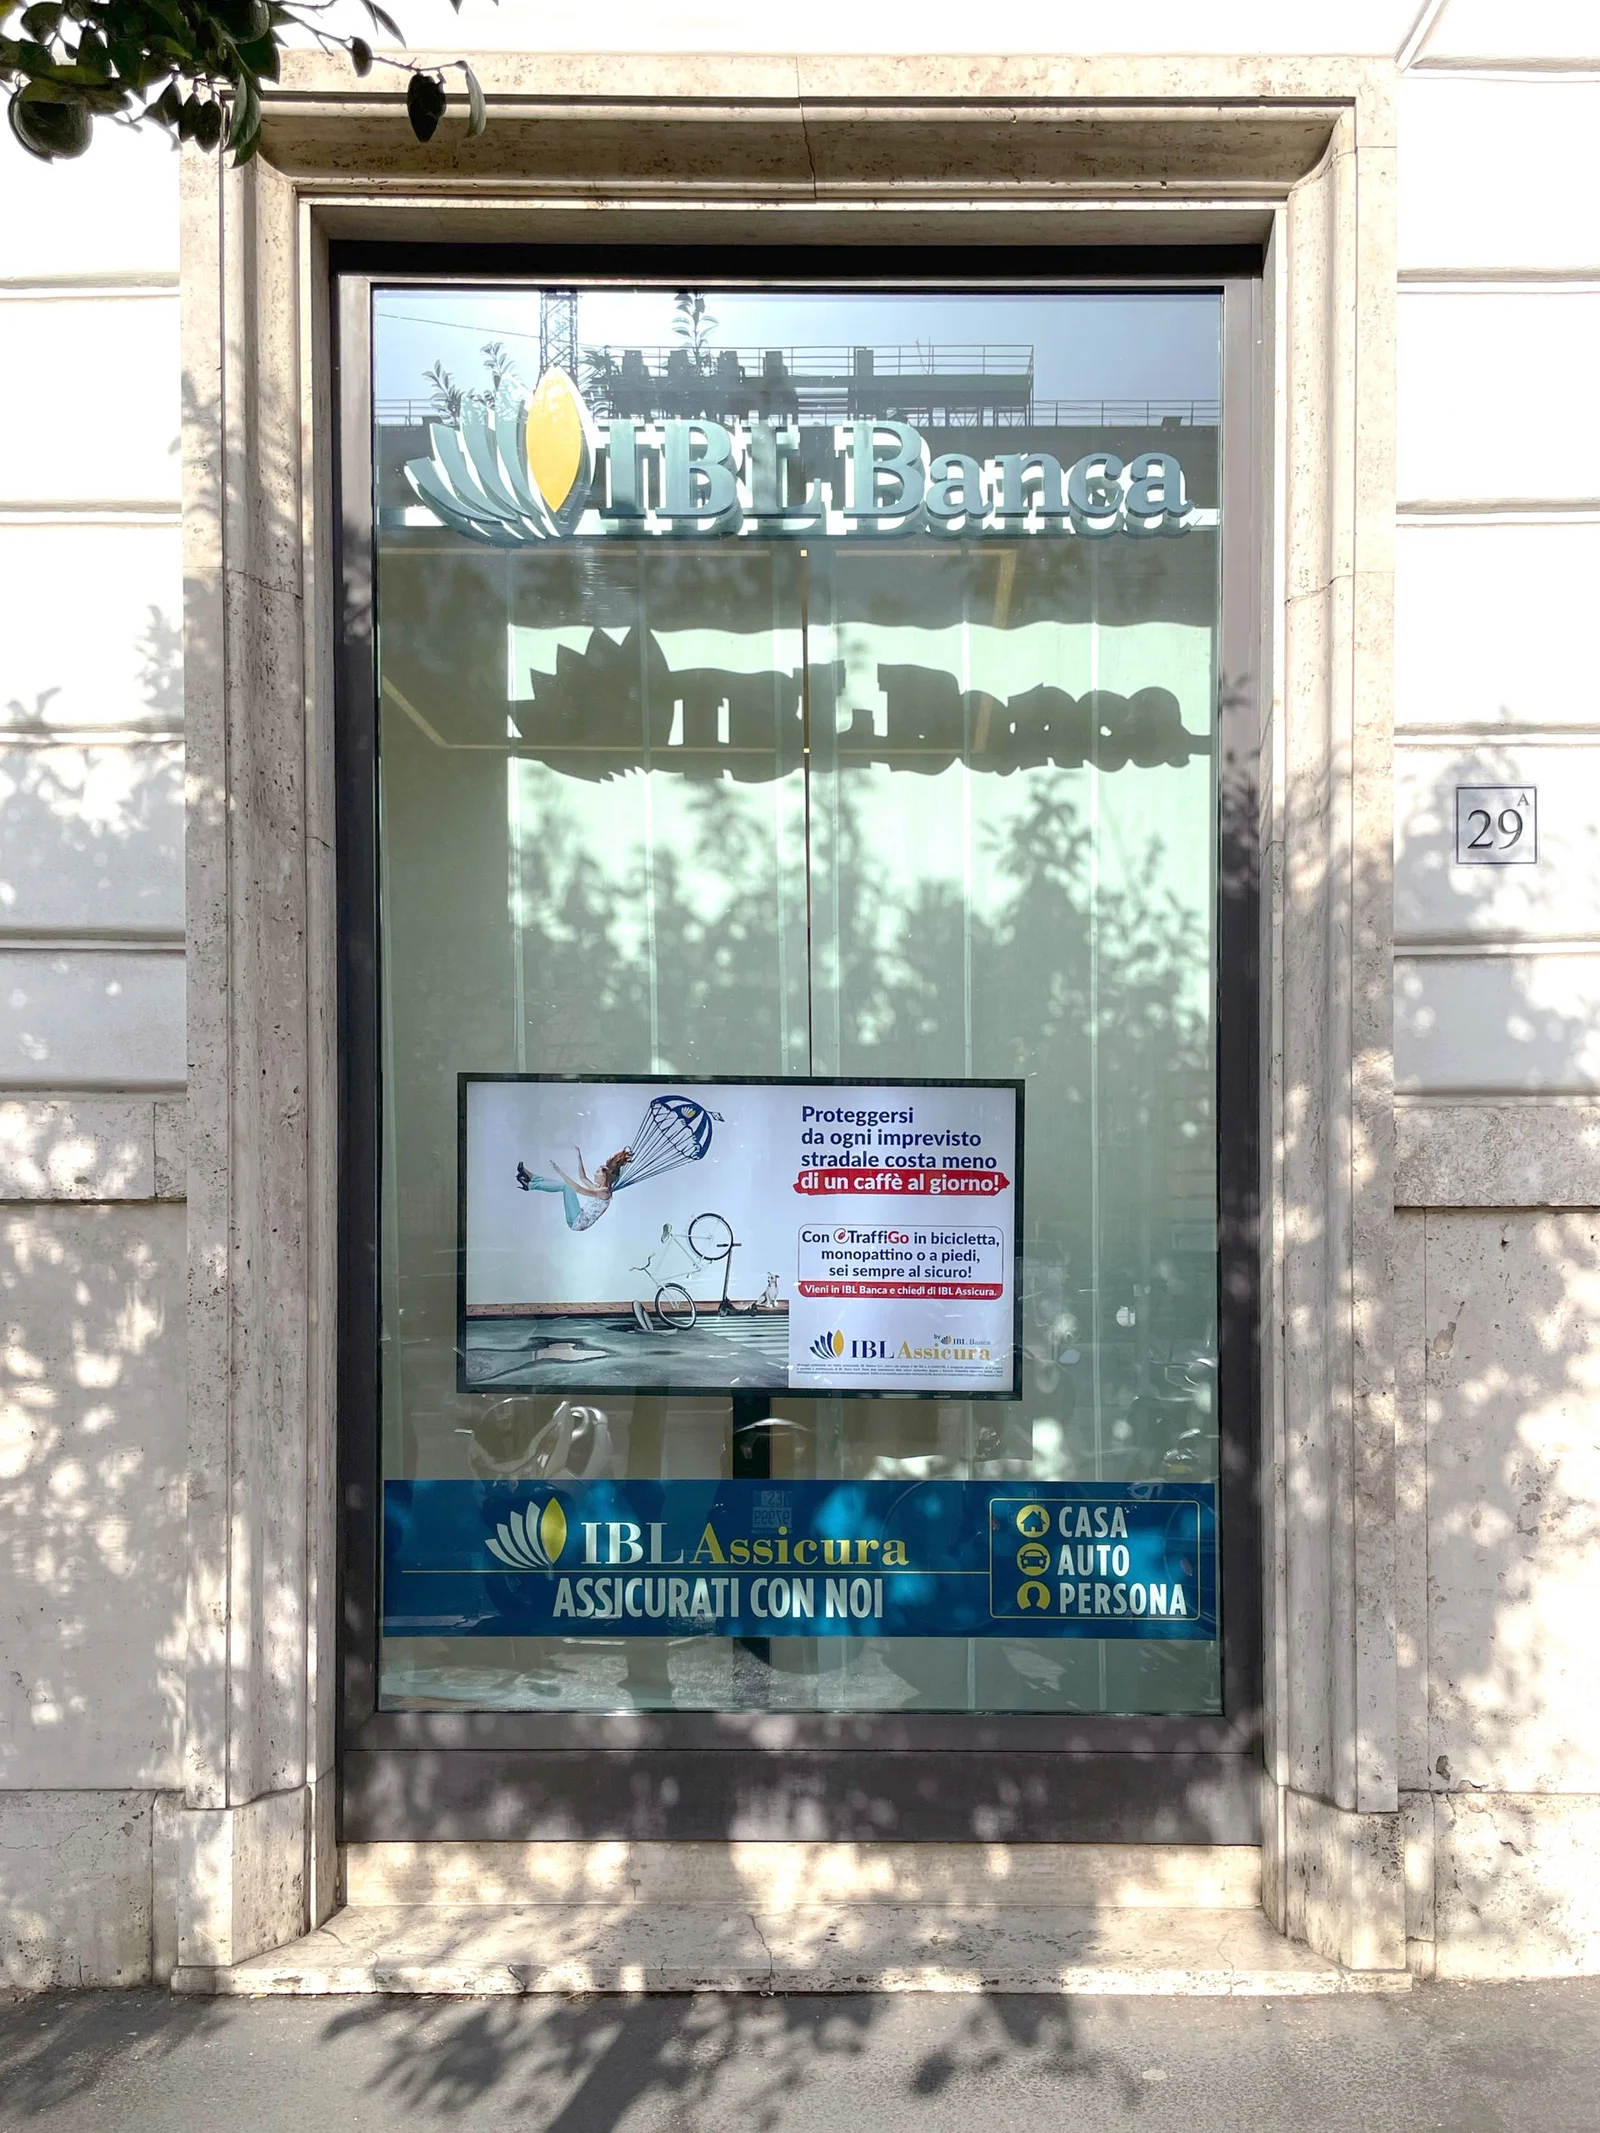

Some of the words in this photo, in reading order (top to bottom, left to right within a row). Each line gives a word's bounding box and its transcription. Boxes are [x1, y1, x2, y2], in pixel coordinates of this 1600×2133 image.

[598, 419, 821, 519] IBL
[843, 420, 1195, 518] Banca
[1467, 808, 1523, 850] 29
[1517, 793, 1530, 806] A
[802, 1106, 914, 1126] Proteggersi
[801, 1128, 824, 1145] da
[830, 1129, 871, 1148] ogni
[878, 1129, 982, 1149] imprevisto
[801, 1151, 879, 1167] stradale
[885, 1153, 936, 1168] costa
[942, 1156, 997, 1169] meno
[801, 1172, 819, 1189] di
[824, 1176, 849, 1190] un
[853, 1172, 903, 1190] caffè
[908, 1173, 924, 1191] al
[929, 1175, 999, 1194] giorno!
[802, 1231, 830, 1243] Con
[914, 1231, 927, 1244] in
[931, 1231, 1000, 1248] bicicletta,
[821, 1249, 913, 1263] monopattino
[917, 1252, 926, 1262] o
[929, 1252, 937, 1262] a
[941, 1249, 980, 1263] piedi,
[829, 1264, 849, 1277] sei
[852, 1267, 905, 1280] sempre
[909, 1265, 920, 1278] al
[924, 1266, 972, 1278] sicuro!
[805, 1285, 829, 1294] Vieni
[831, 1285, 840, 1294] in
[842, 1286, 857, 1294] IBL
[860, 1286, 887, 1295] Banca
[897, 1286, 925, 1295] chiedi
[927, 1287, 936, 1295] di
[938, 1287, 953, 1296] IBL
[955, 1287, 997, 1296] Assicura.
[851, 1340, 895, 1359] IBL
[897, 1341, 991, 1361] Assicura
[1058, 1506, 1128, 1538] CASA
[581, 1522, 684, 1564] IBL
[689, 1522, 909, 1566] Assicura
[1057, 1544, 1130, 1576] AUTO
[552, 1577, 739, 1618] ASSICURATI
[750, 1577, 814, 1618] CON
[825, 1578, 883, 1618] NOI
[1059, 1582, 1187, 1615] PERSONA
